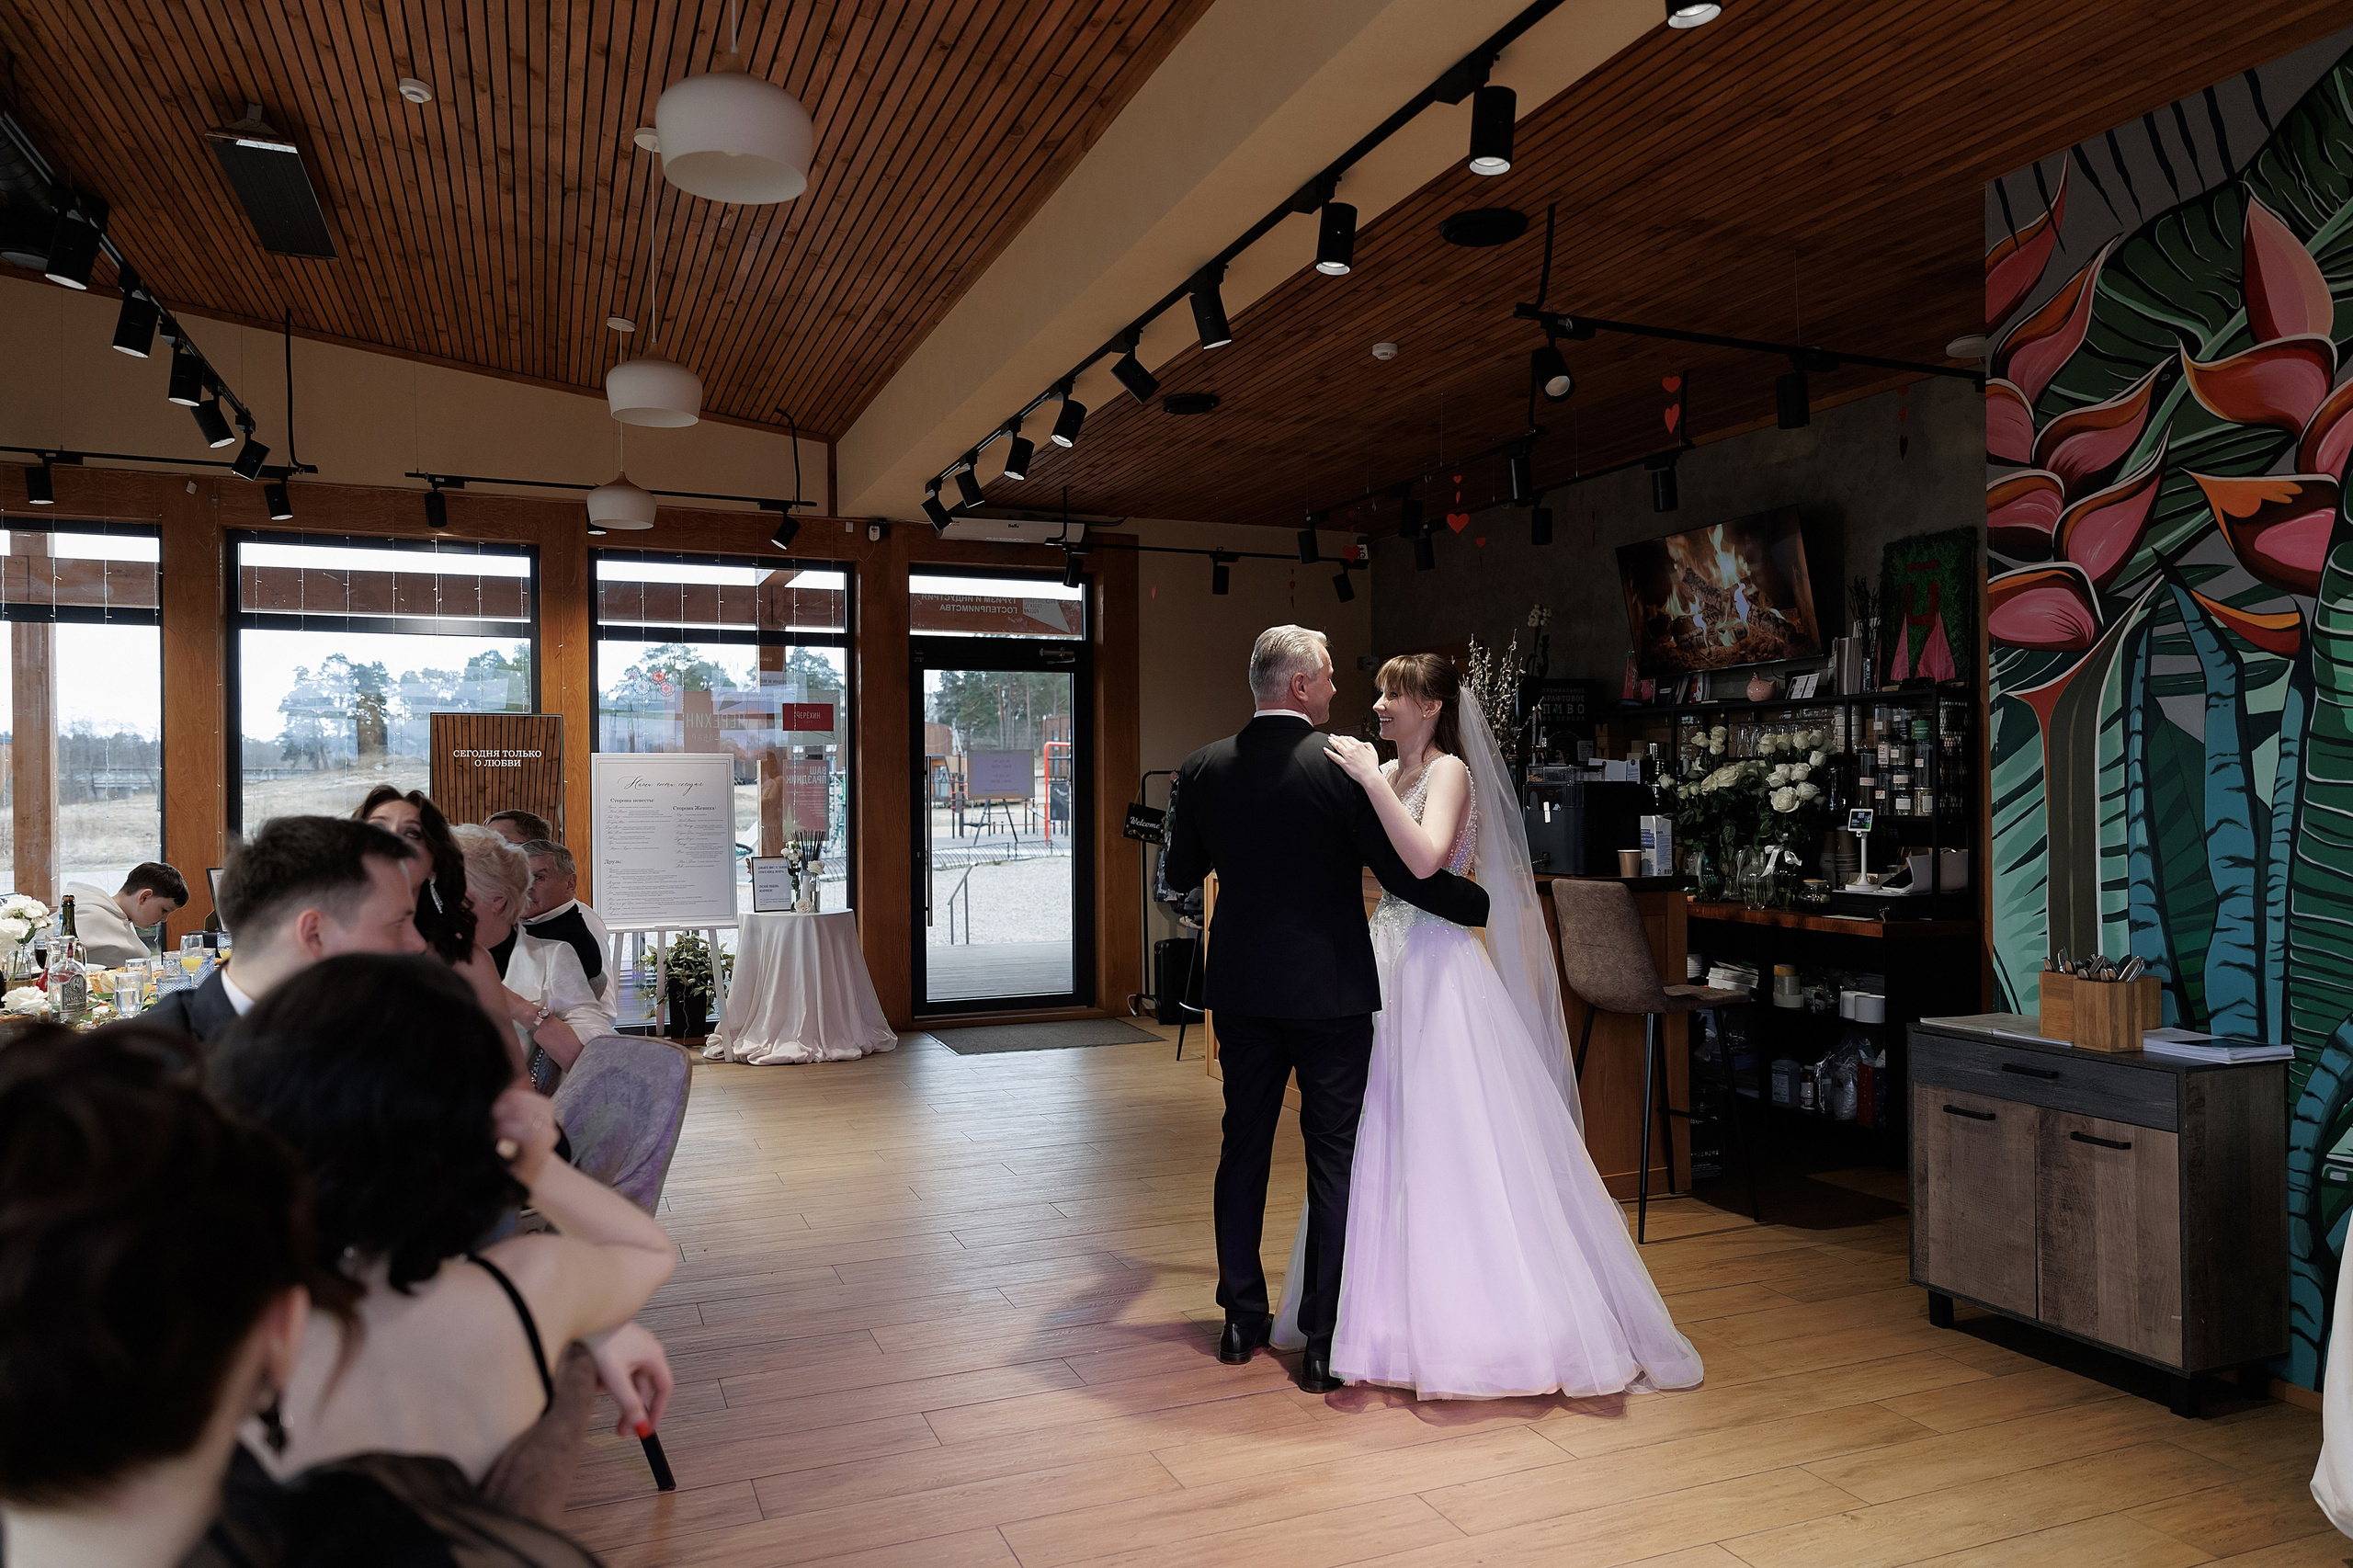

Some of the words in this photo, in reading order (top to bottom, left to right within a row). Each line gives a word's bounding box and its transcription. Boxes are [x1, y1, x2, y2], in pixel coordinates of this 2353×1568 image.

[1542, 703, 1586, 714] ПИВО
[453, 750, 500, 758] СЕГОДНЯ
[483, 759, 521, 767] ЛЮБВИ
[1130, 816, 1161, 829] Welcome
